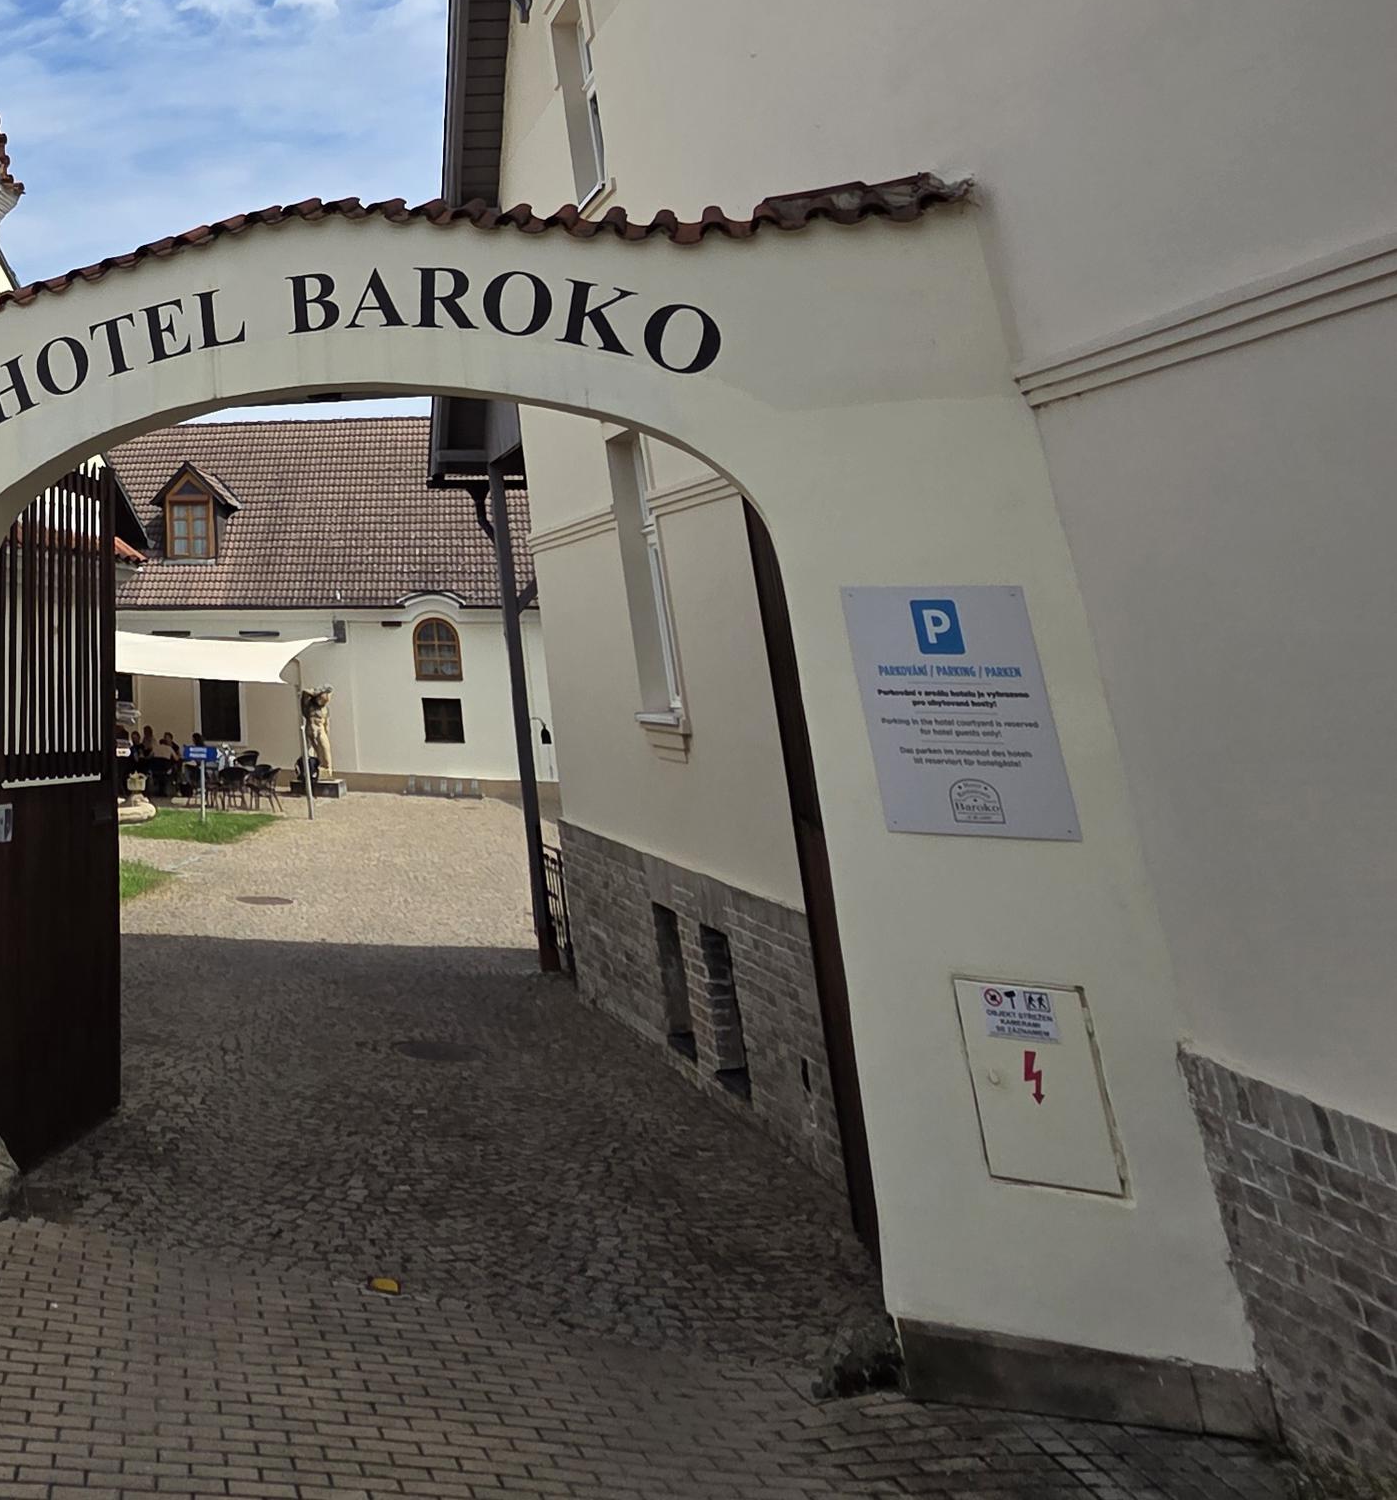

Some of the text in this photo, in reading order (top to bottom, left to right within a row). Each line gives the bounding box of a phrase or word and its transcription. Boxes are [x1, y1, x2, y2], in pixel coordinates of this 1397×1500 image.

[284, 267, 722, 374] BAROKO
[921, 609, 951, 644] P
[878, 664, 928, 676] PARKOVÁNÍ
[936, 665, 976, 678] PARKING
[984, 666, 1022, 678] PARKEN
[949, 689, 977, 698] hotelu
[976, 690, 985, 699] je
[970, 700, 998, 709] hosty!
[881, 717, 911, 726] Parking
[920, 718, 933, 726] the
[933, 717, 955, 726] hotel
[956, 719, 994, 728] courtyard
[995, 720, 1002, 728] is
[1003, 721, 1039, 729] reserved
[932, 728, 954, 736] hotel
[954, 729, 981, 738] guests
[981, 730, 1002, 739] only!
[899, 746, 914, 754] Das
[914, 747, 943, 755] parken
[943, 748, 955, 756] im
[991, 750, 1006, 758] des
[1006, 750, 1033, 758] hotels
[924, 757, 963, 766] reserviert
[963, 758, 976, 766] für
[954, 802, 1000, 812] Baroko
[986, 1009, 1016, 1018] OBJEKT
